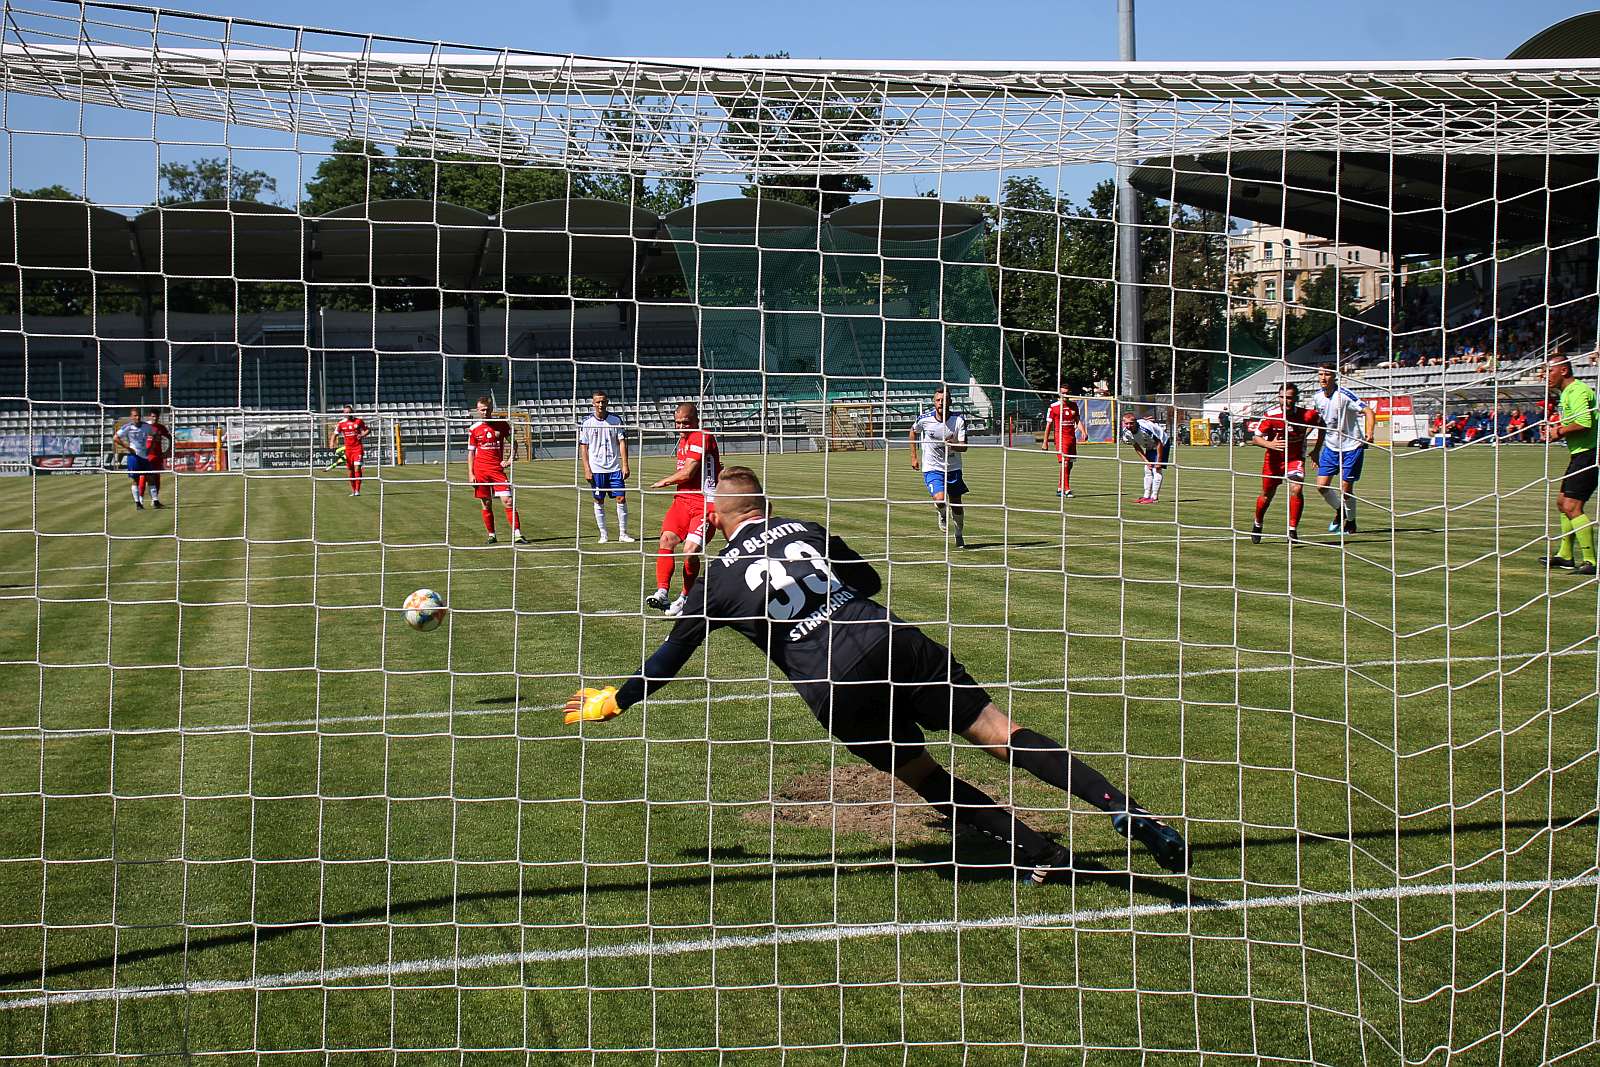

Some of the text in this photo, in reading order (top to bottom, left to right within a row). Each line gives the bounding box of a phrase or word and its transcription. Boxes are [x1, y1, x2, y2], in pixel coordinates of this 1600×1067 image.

[262, 451, 283, 459] PIAST
[721, 547, 740, 568] KP
[789, 590, 854, 642] STARGARD
